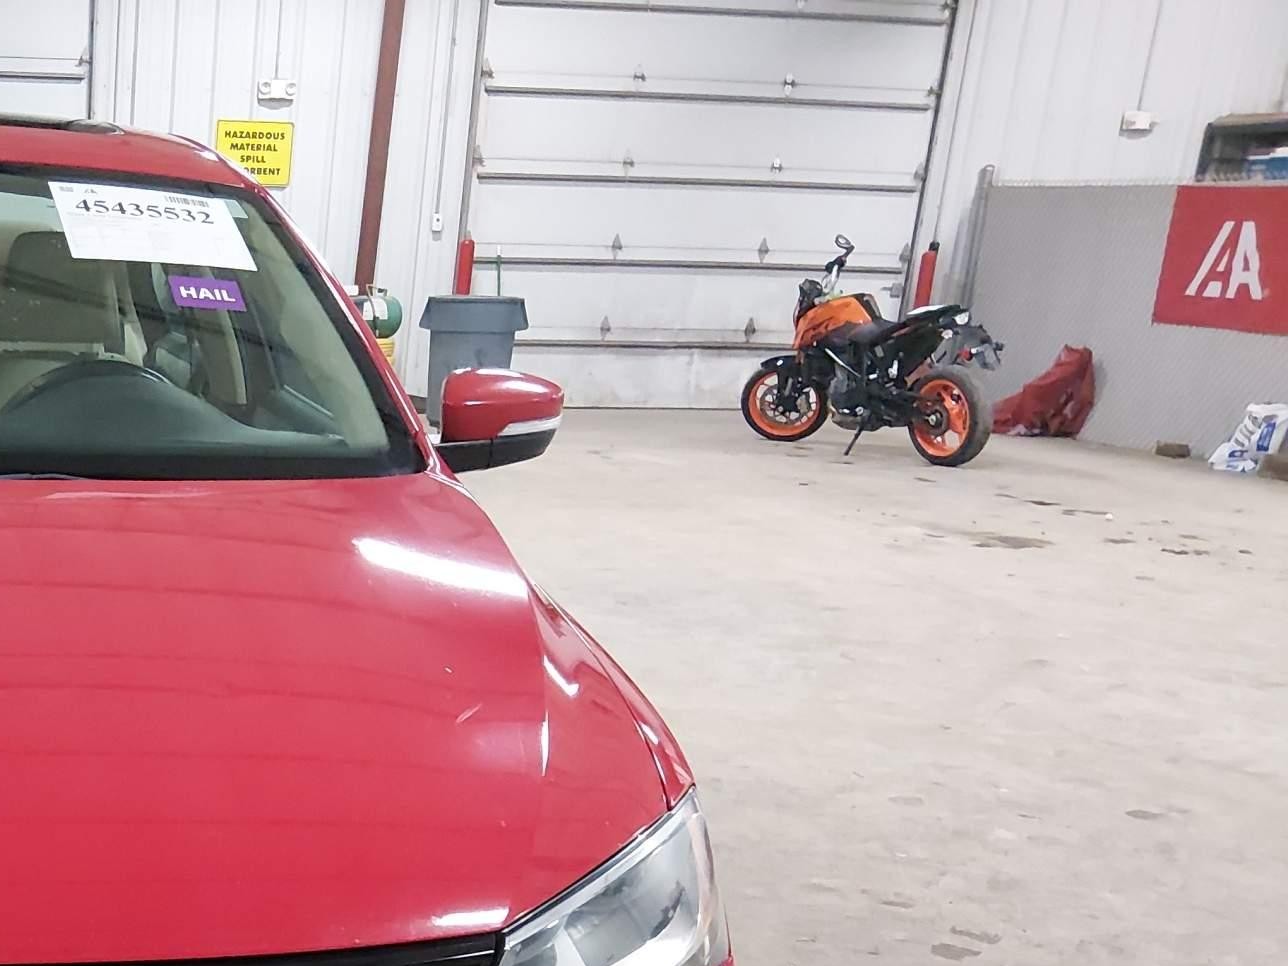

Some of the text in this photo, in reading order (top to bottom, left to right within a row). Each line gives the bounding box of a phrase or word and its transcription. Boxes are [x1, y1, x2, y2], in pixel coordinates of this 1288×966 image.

[224, 130, 286, 140] HAZARDOUS
[229, 143, 278, 152] MATERIAL
[240, 155, 267, 163] SPILL
[75, 199, 214, 224] 45435532
[179, 285, 236, 302] HAIL
